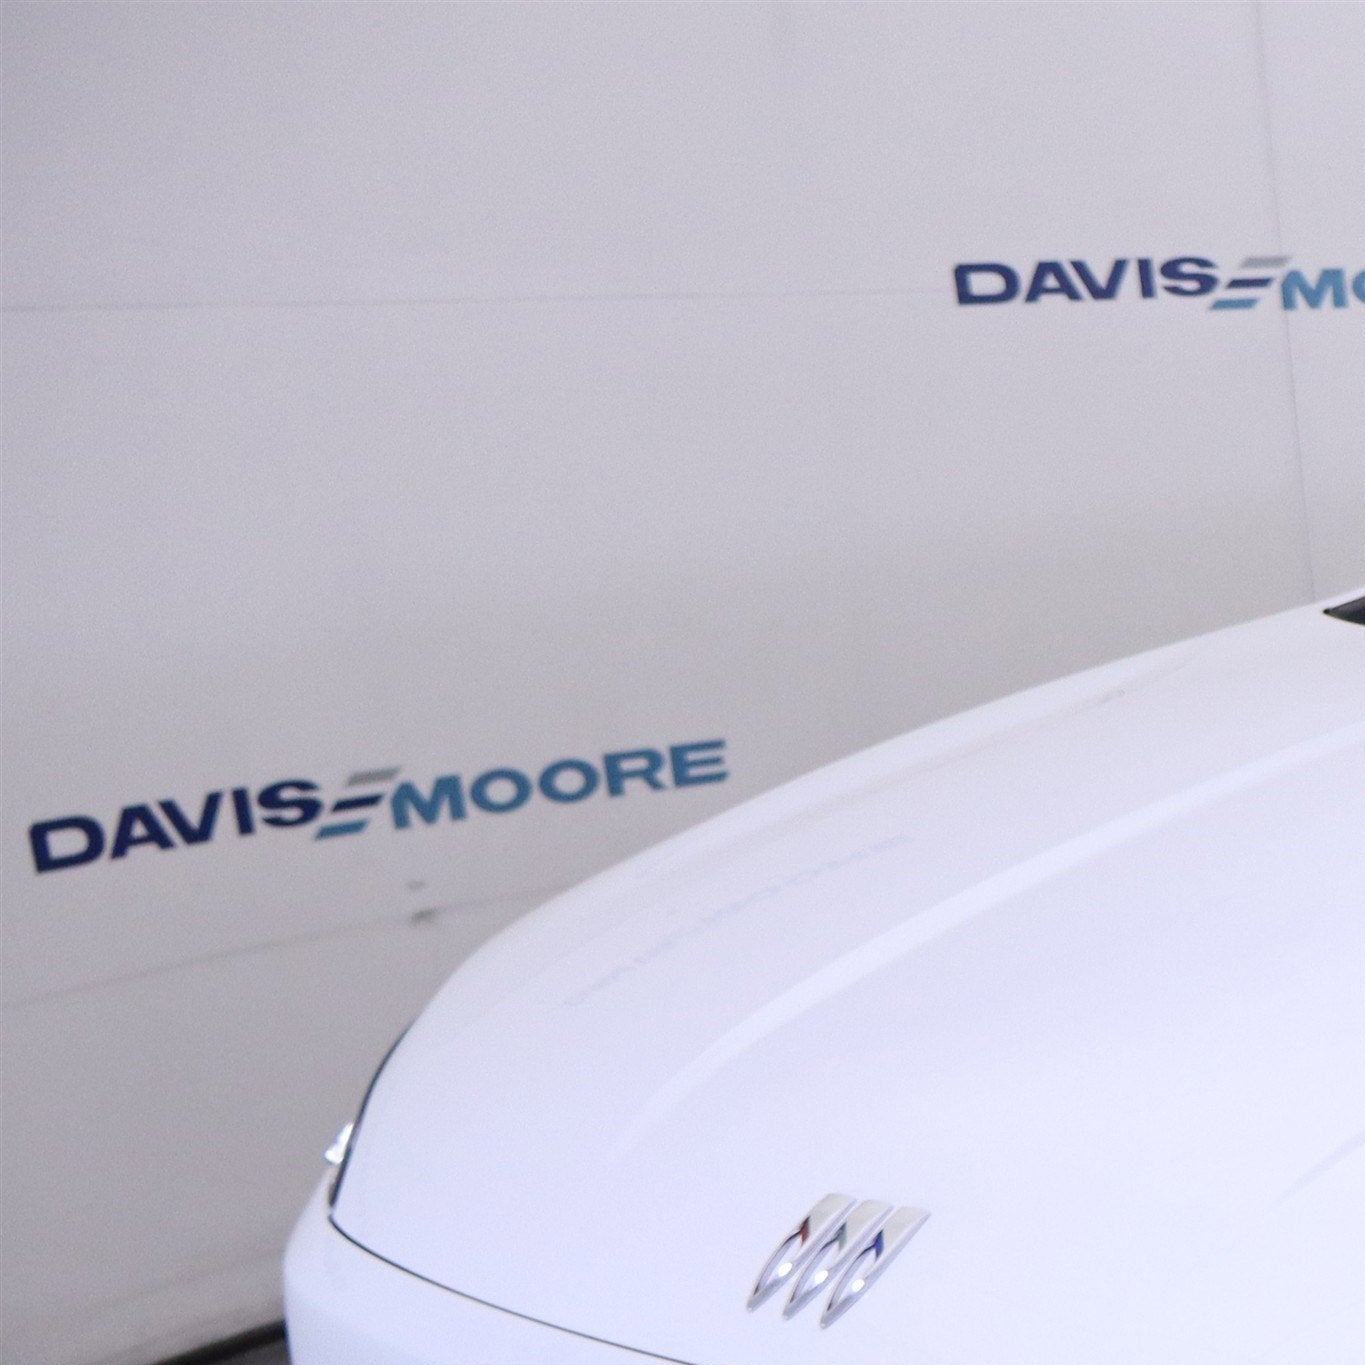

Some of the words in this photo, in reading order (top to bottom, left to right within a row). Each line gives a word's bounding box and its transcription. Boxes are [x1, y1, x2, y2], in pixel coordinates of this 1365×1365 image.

[953, 257, 1217, 305] DAVIS
[28, 780, 322, 873] DAVIS
[390, 739, 729, 829] MOORE
